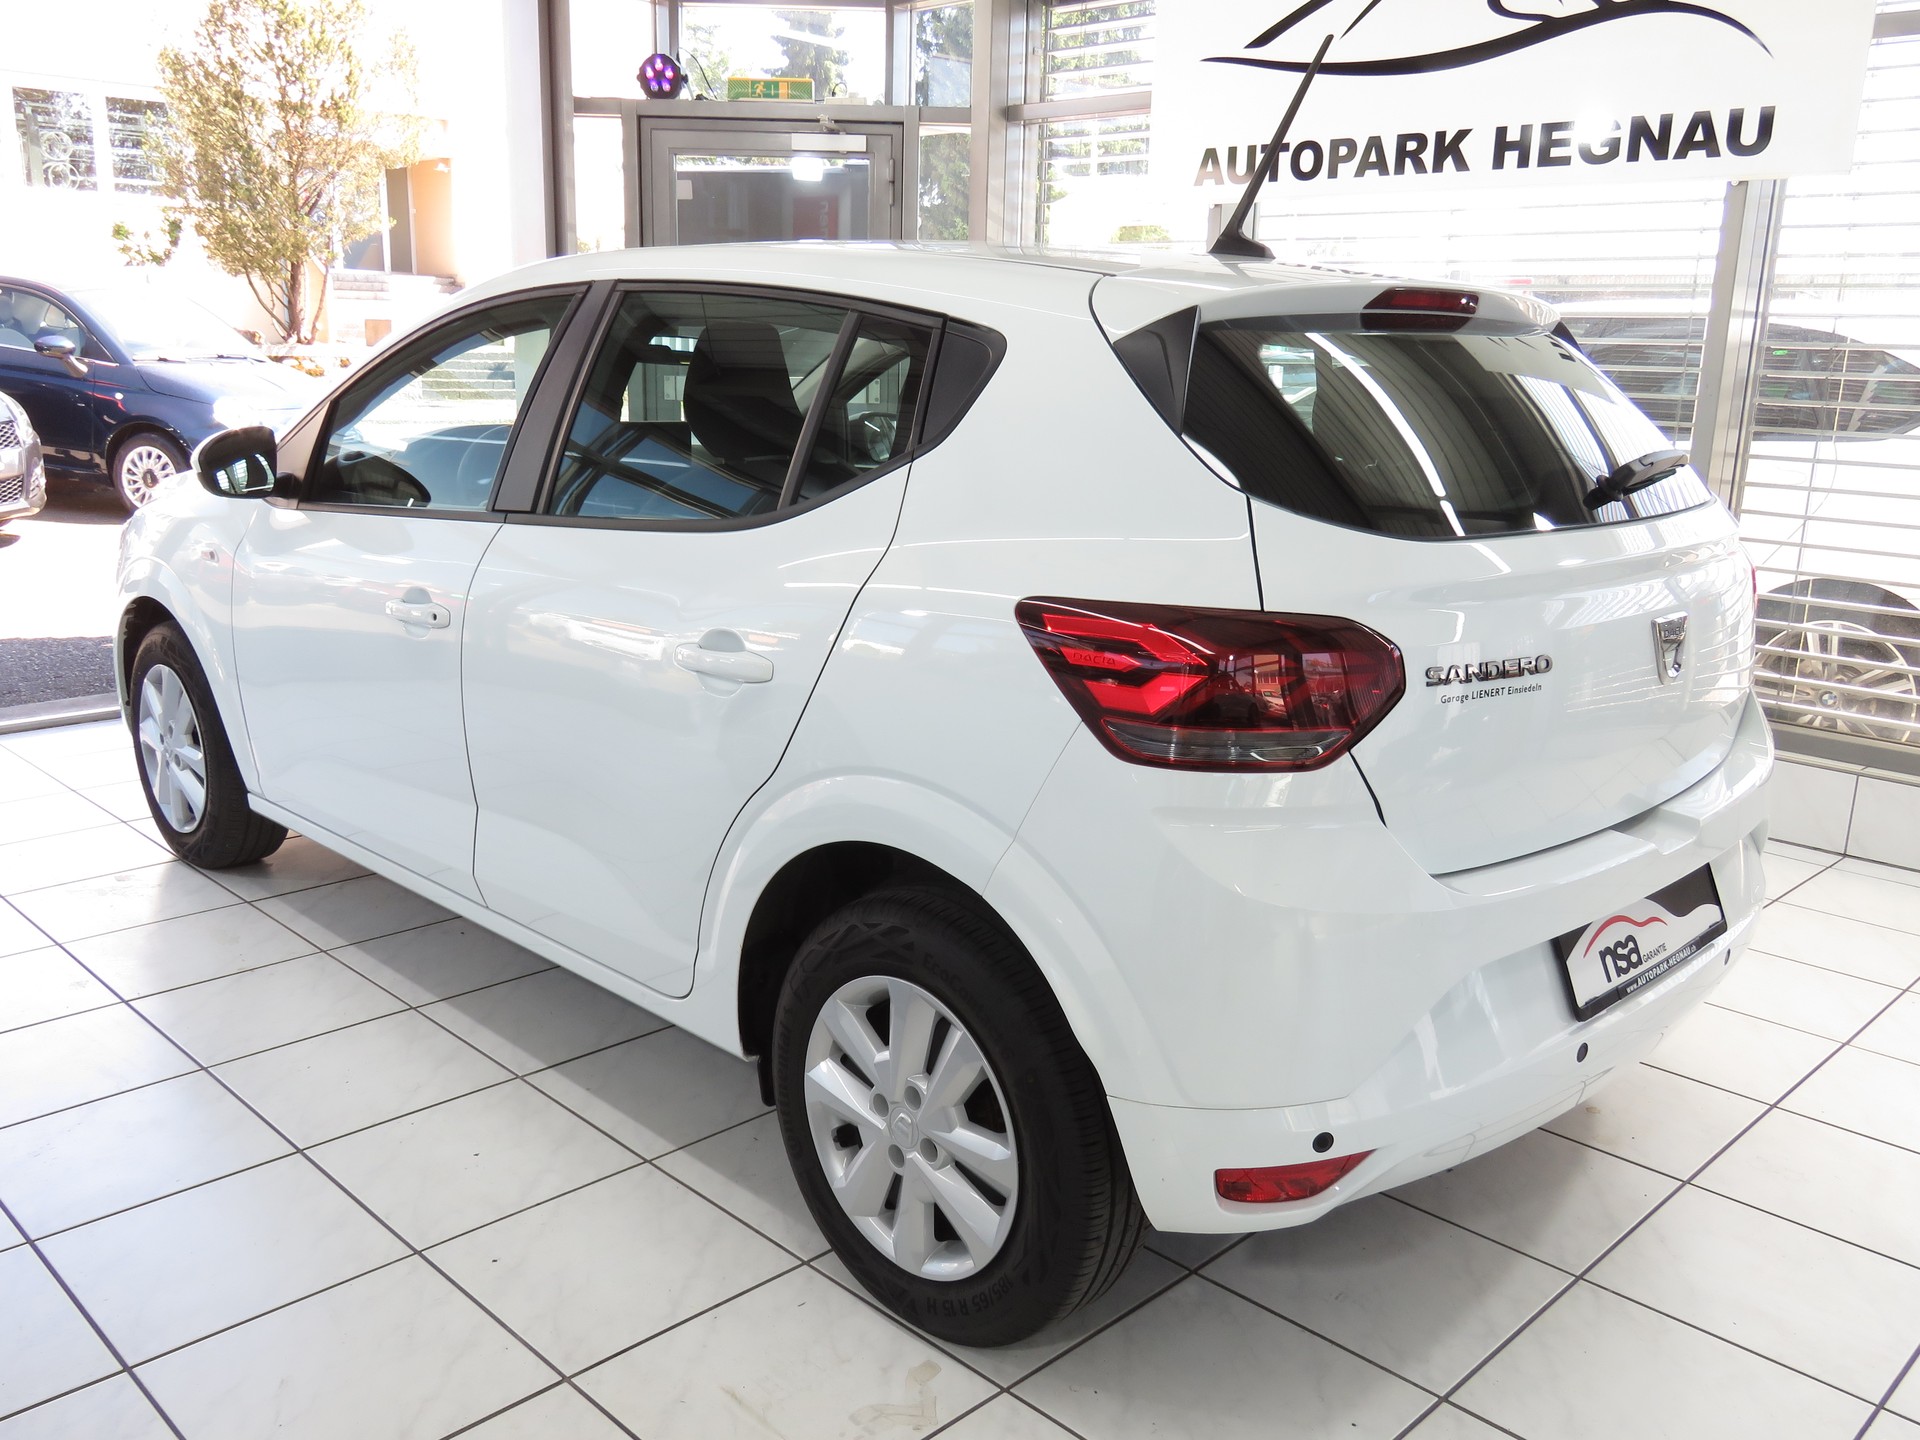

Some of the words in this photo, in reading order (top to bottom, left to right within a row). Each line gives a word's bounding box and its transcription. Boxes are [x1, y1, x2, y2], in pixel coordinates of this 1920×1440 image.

[1193, 129, 1474, 187] AUTOPARK
[1492, 106, 1776, 170] HEGNAU
[1073, 652, 1116, 665] DACIA
[1425, 654, 1553, 687] SANDERO
[1440, 693, 1469, 704] Garage
[1471, 687, 1506, 700] LIENERT
[1507, 683, 1542, 695] Einsiedeln
[1598, 934, 1643, 983] nsa
[1642, 943, 1667, 963] GARANTIE
[1626, 945, 1697, 994] www.AUTOPARK-HEGNAU.ch
[972, 1272, 1014, 1313] 185/65
